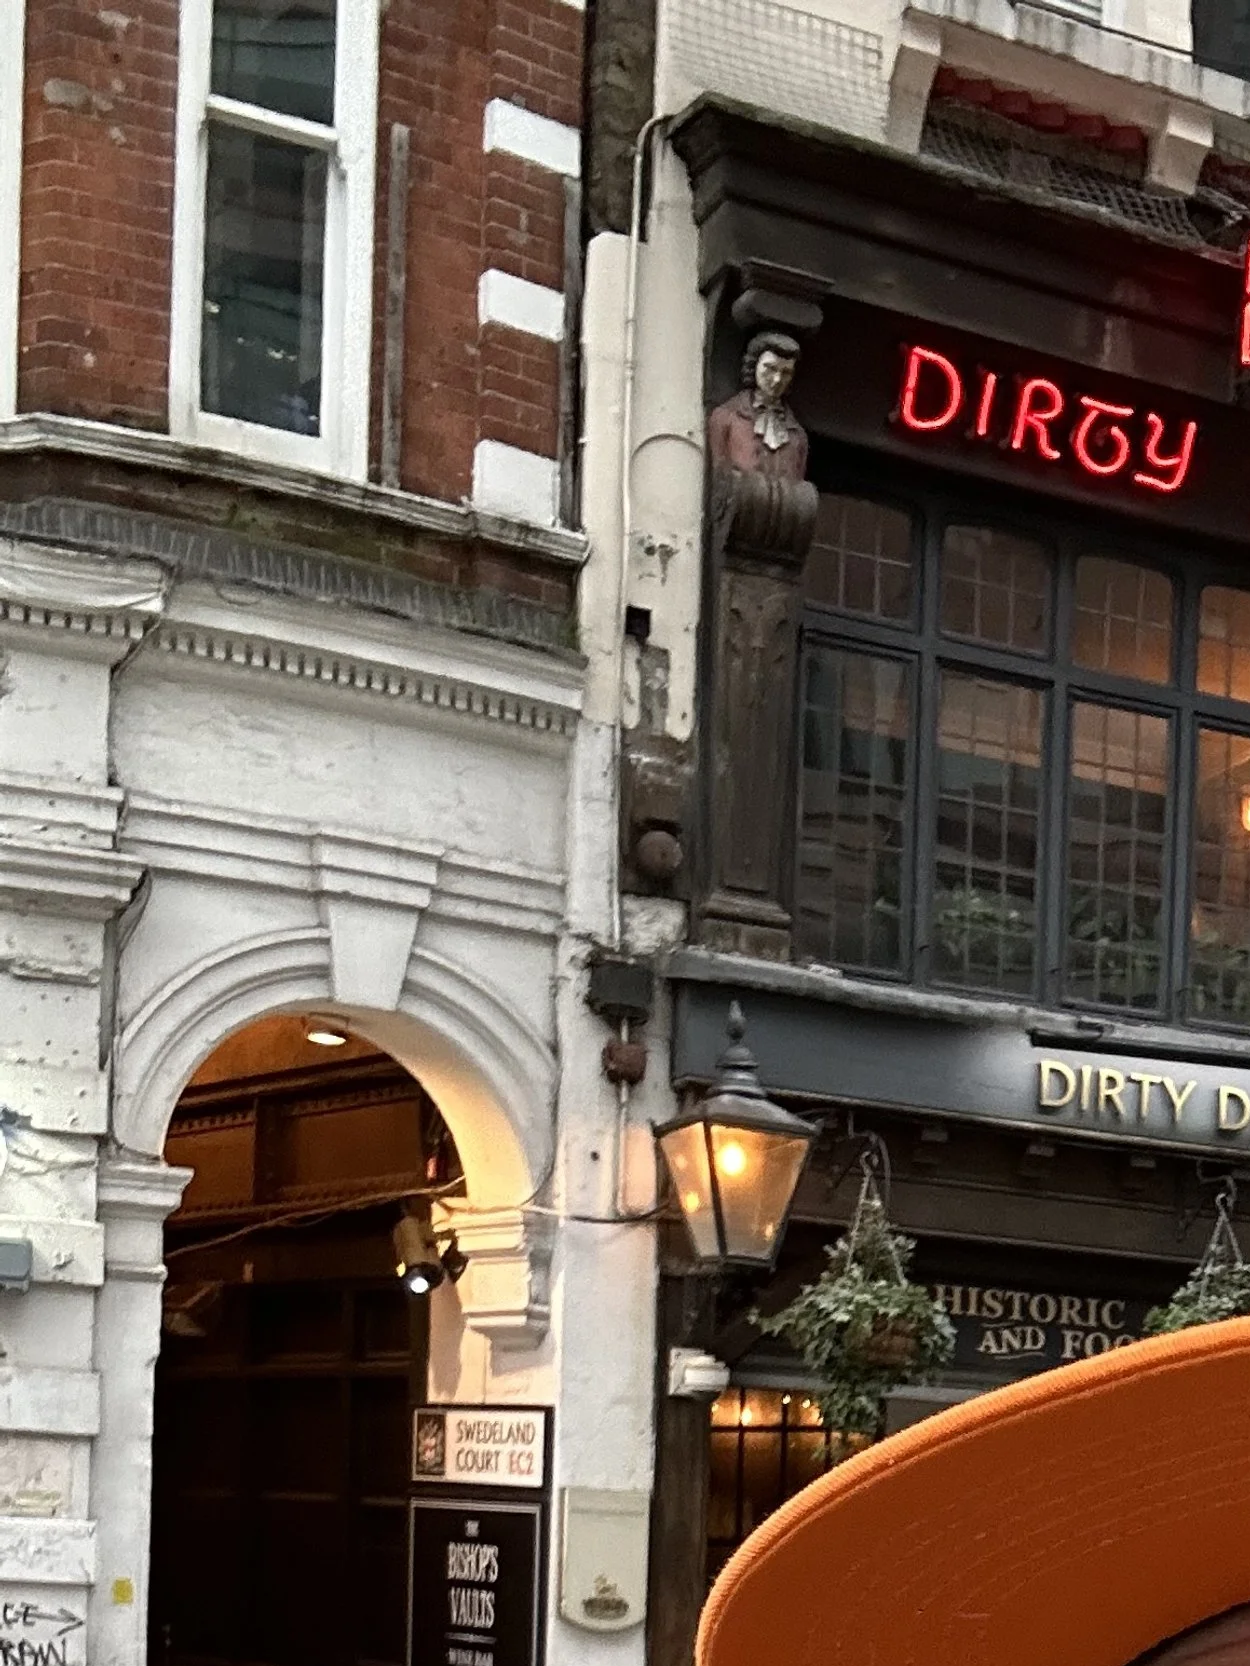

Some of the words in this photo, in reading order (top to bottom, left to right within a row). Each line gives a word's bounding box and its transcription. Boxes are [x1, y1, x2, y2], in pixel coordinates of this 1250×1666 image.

[1038, 1060, 1197, 1123] DIRTY
[936, 1284, 1126, 1330] HISTORIC
[977, 1326, 1046, 1354] AND
[455, 1419, 536, 1445] SWEDELAND
[456, 1447, 501, 1473] COURT
[508, 1449, 535, 1475] EC2
[449, 1586, 496, 1628] VAULTS
